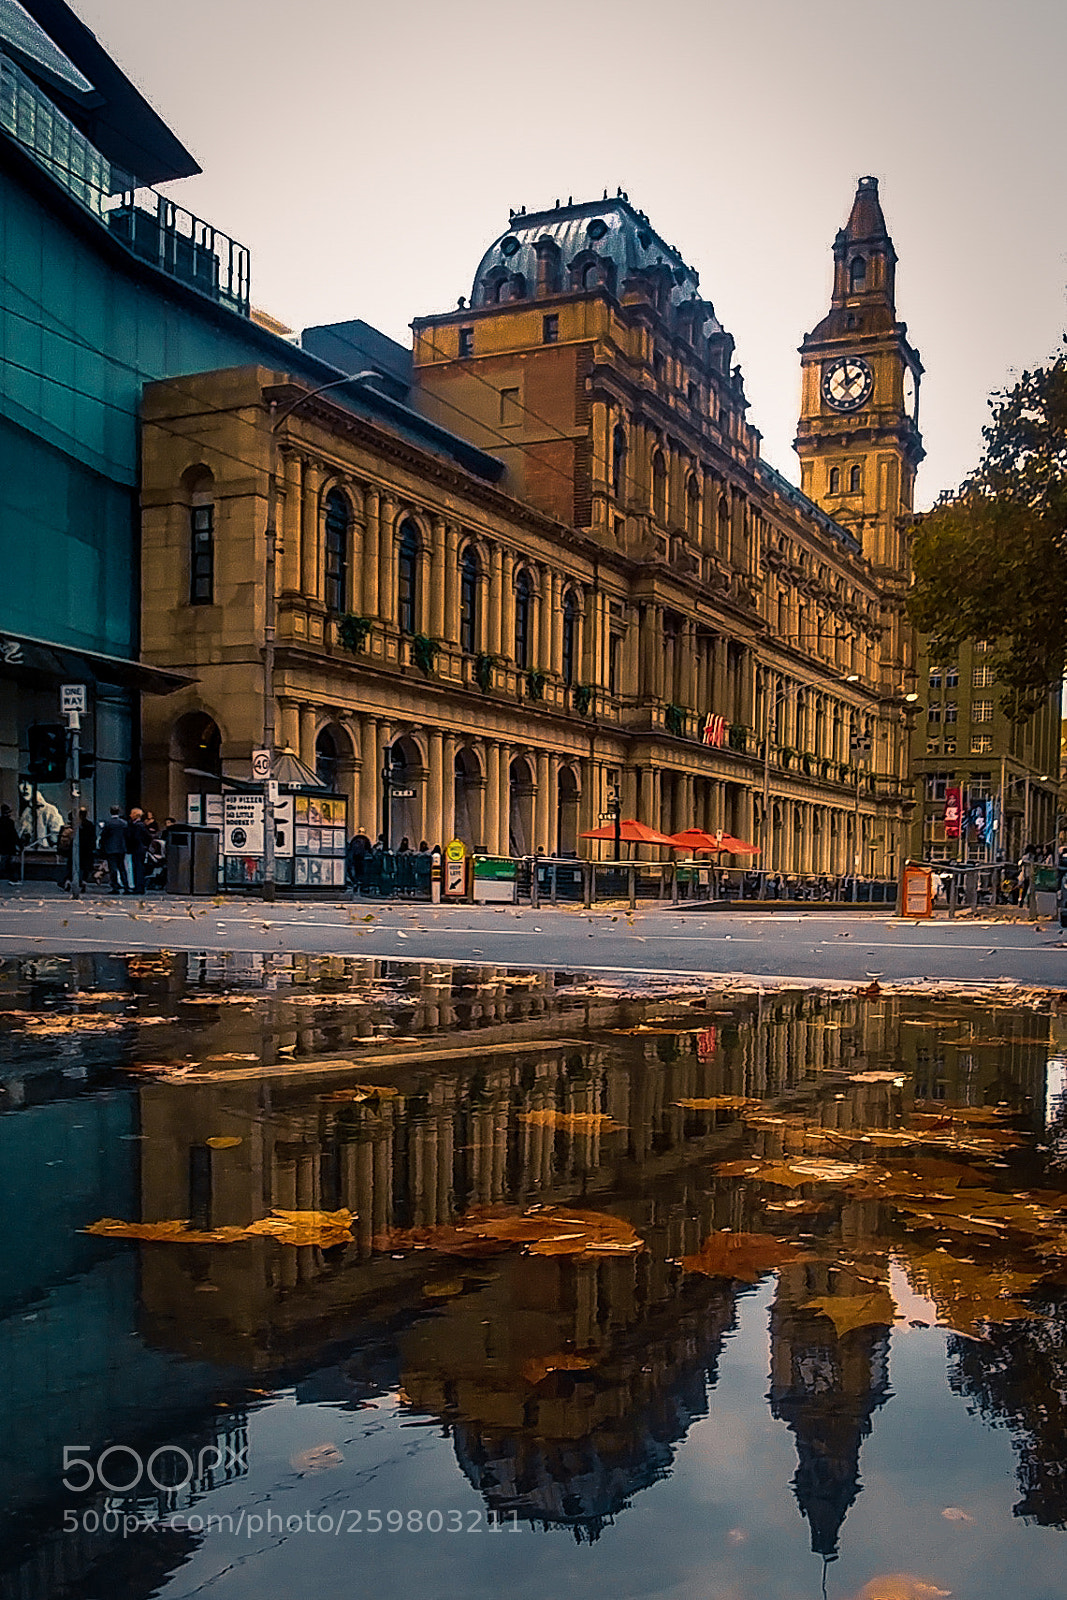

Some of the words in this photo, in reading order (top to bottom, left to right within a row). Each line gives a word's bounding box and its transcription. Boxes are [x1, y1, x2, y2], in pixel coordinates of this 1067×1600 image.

[64, 687, 83, 696] ONE
[64, 697, 83, 705] WAY
[254, 759, 268, 770] 40
